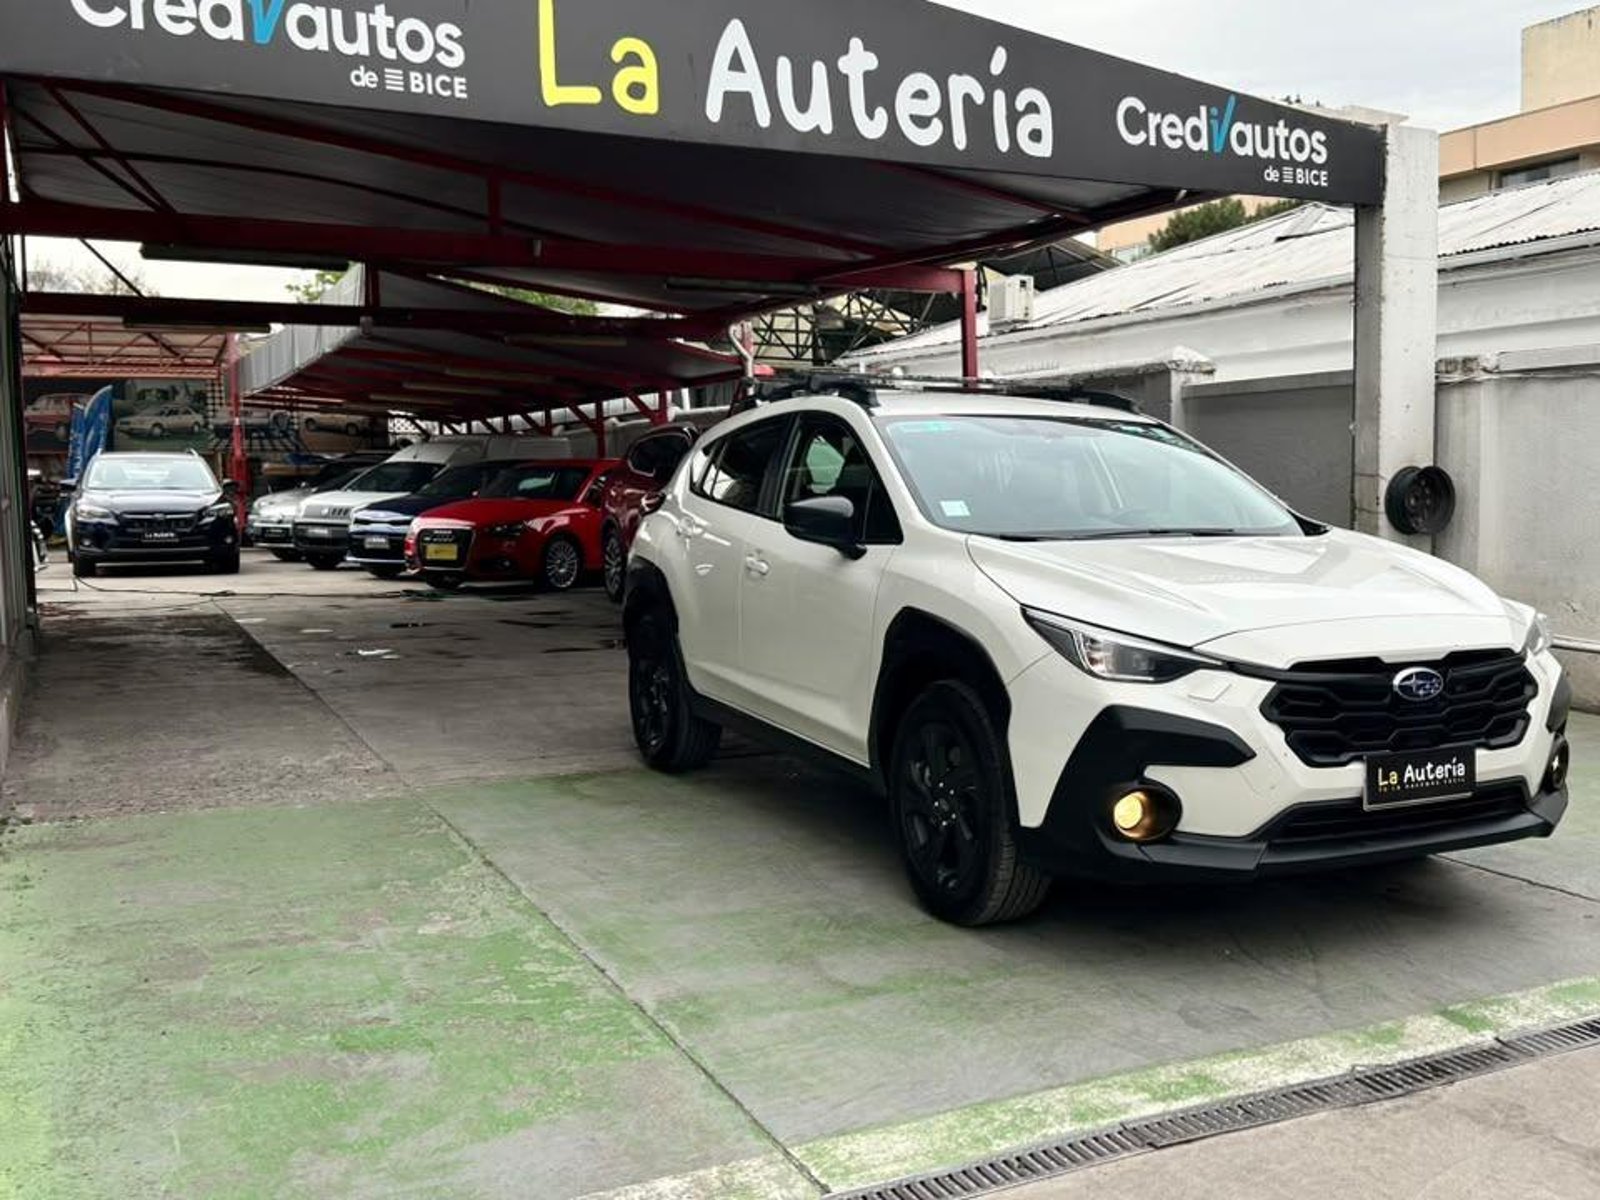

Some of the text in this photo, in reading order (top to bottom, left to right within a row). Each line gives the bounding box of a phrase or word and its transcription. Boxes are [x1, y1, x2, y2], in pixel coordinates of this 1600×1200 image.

[350, 65, 469, 99] de BICE
[538, 0, 1054, 158] La Autería
[1264, 165, 1328, 187] de BICE
[1378, 767, 1398, 786] La
[1403, 756, 1466, 783] Autería
